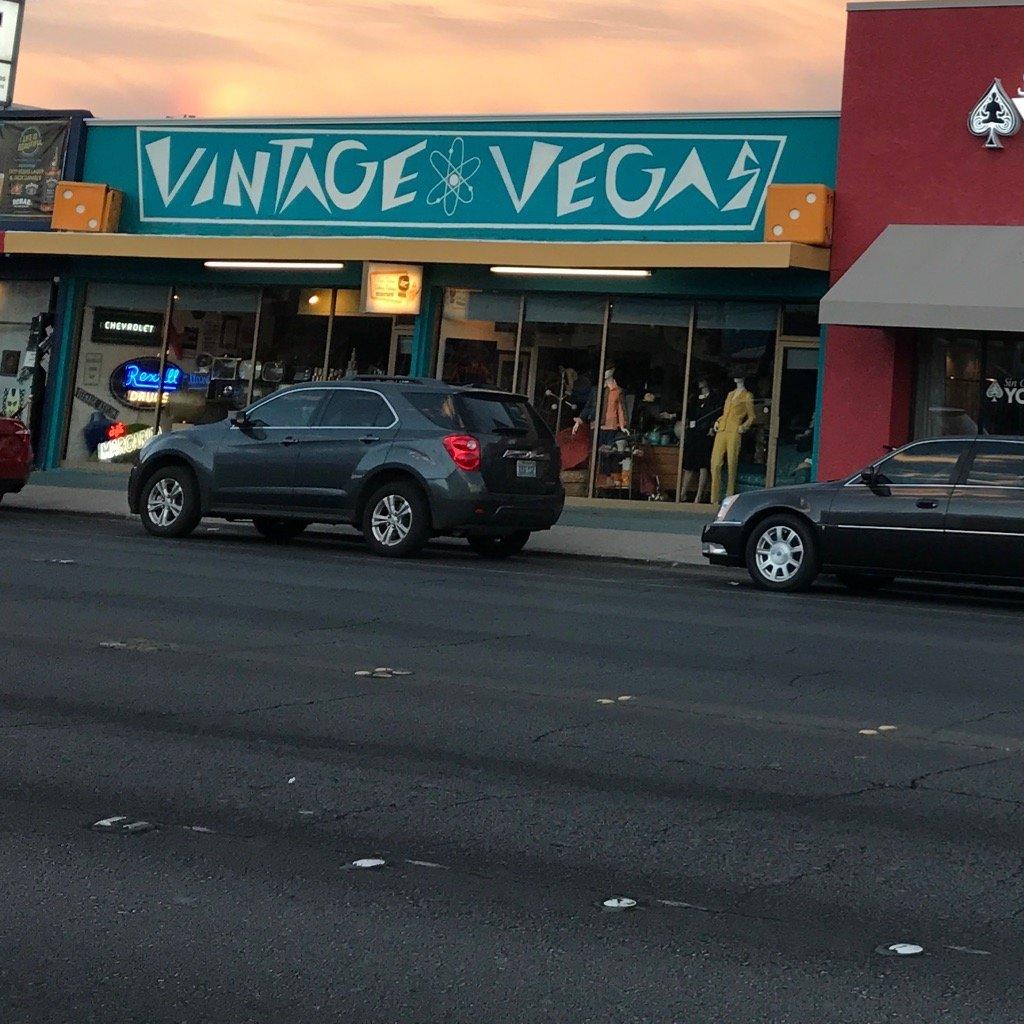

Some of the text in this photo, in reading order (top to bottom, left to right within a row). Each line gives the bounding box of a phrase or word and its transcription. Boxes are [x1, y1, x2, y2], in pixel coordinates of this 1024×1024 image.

[145, 134, 761, 219] VINTAGE VEGAS
[104, 321, 155, 333] CHEVROLET
[125, 365, 180, 387] Rexll
[1004, 378, 1018, 387] Sin
